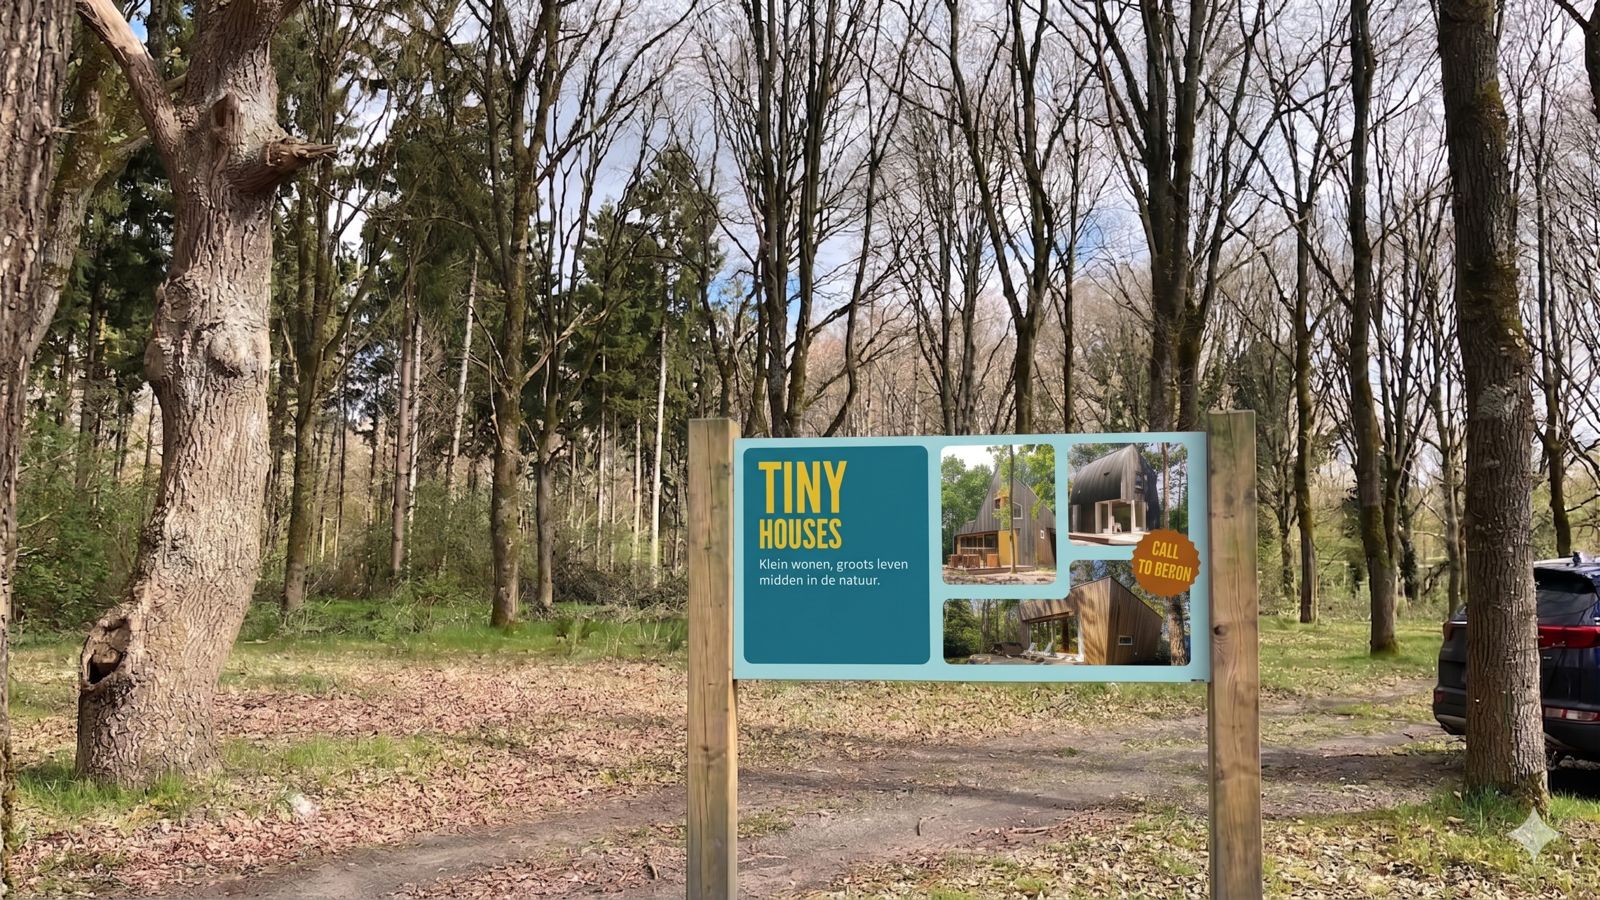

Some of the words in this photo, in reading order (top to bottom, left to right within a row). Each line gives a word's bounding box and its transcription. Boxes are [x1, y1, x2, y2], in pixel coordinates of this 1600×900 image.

[757, 461, 848, 514] TINY
[759, 518, 842, 550] HOUSES
[1152, 540, 1179, 559] CALL
[759, 558, 788, 570] Klein
[791, 561, 833, 573] wonen,
[836, 560, 874, 573] groots
[877, 558, 908, 570] leven
[1138, 558, 1153, 576] TO
[1154, 561, 1192, 582] BERON
[759, 574, 803, 586] midden
[807, 574, 818, 586] in
[821, 574, 836, 586] de
[839, 576, 880, 586] natuur.
